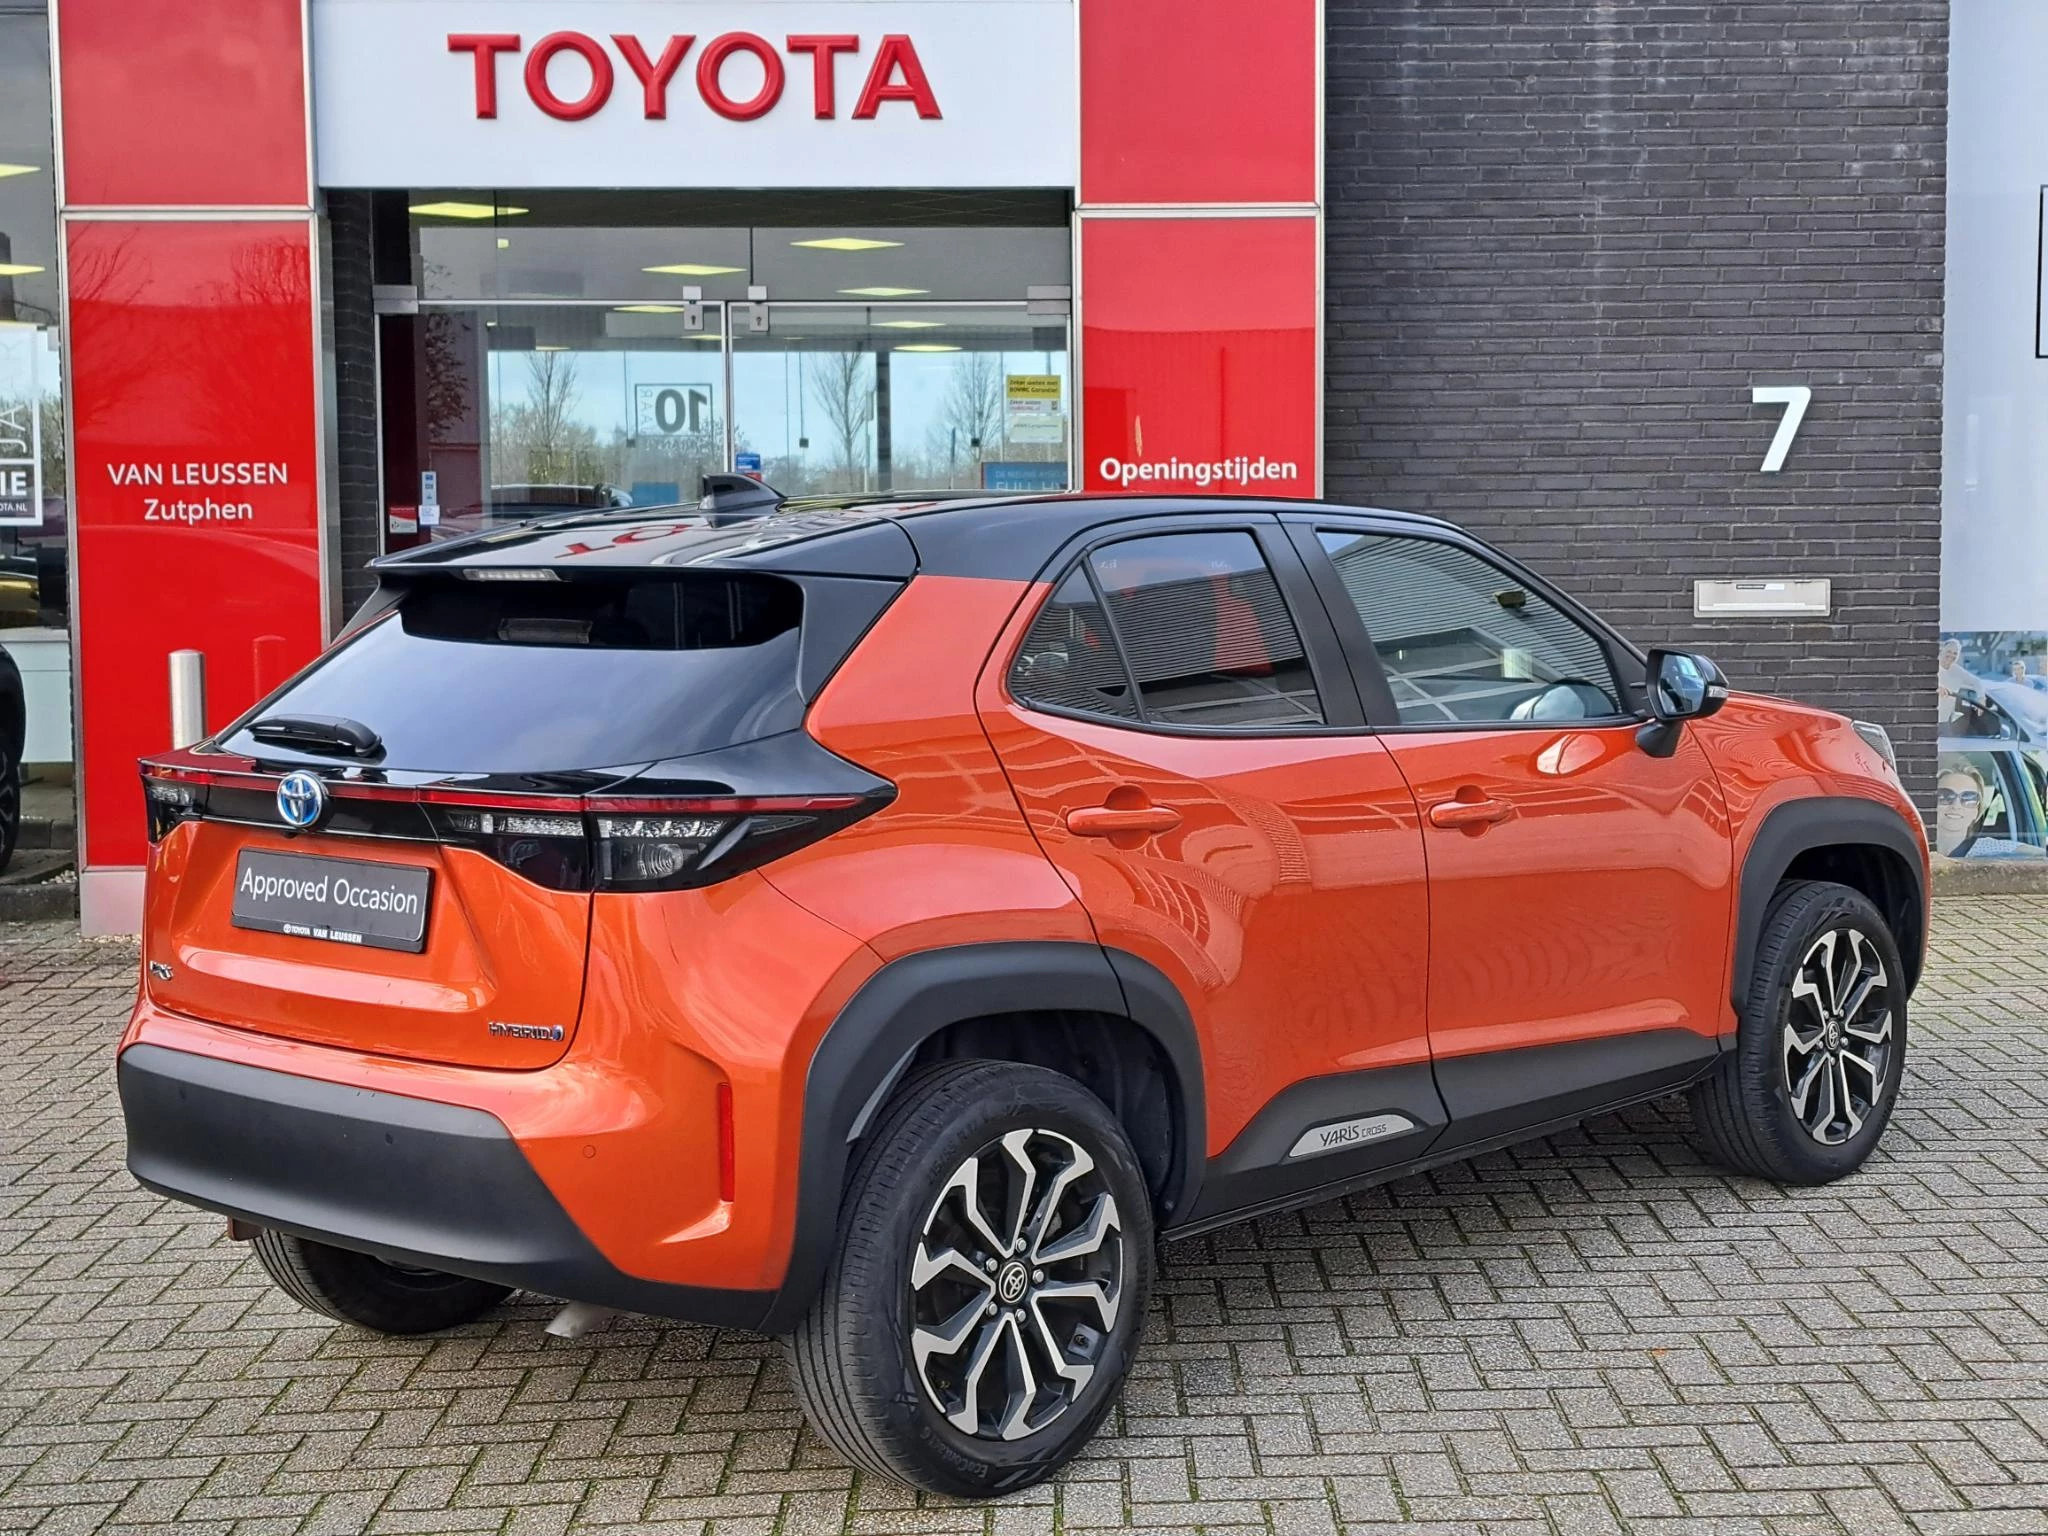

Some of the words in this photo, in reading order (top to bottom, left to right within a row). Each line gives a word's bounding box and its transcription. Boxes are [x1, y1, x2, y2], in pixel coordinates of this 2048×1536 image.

[447, 31, 943, 122] TOYOTA
[1753, 387, 1811, 471] 7
[107, 463, 163, 486] VAN
[172, 462, 288, 485] LEUSSEN
[1100, 456, 1297, 487] Openingstijden
[144, 497, 253, 525] Zutphen
[240, 867, 328, 902] Approved
[333, 878, 418, 915] Occasion
[291, 925, 310, 936] TOYOTA
[313, 928, 327, 938] VAN
[330, 930, 362, 943] LEUSSEN
[488, 1021, 553, 1041] HYBRID
[1361, 1124, 1387, 1138] CROSS
